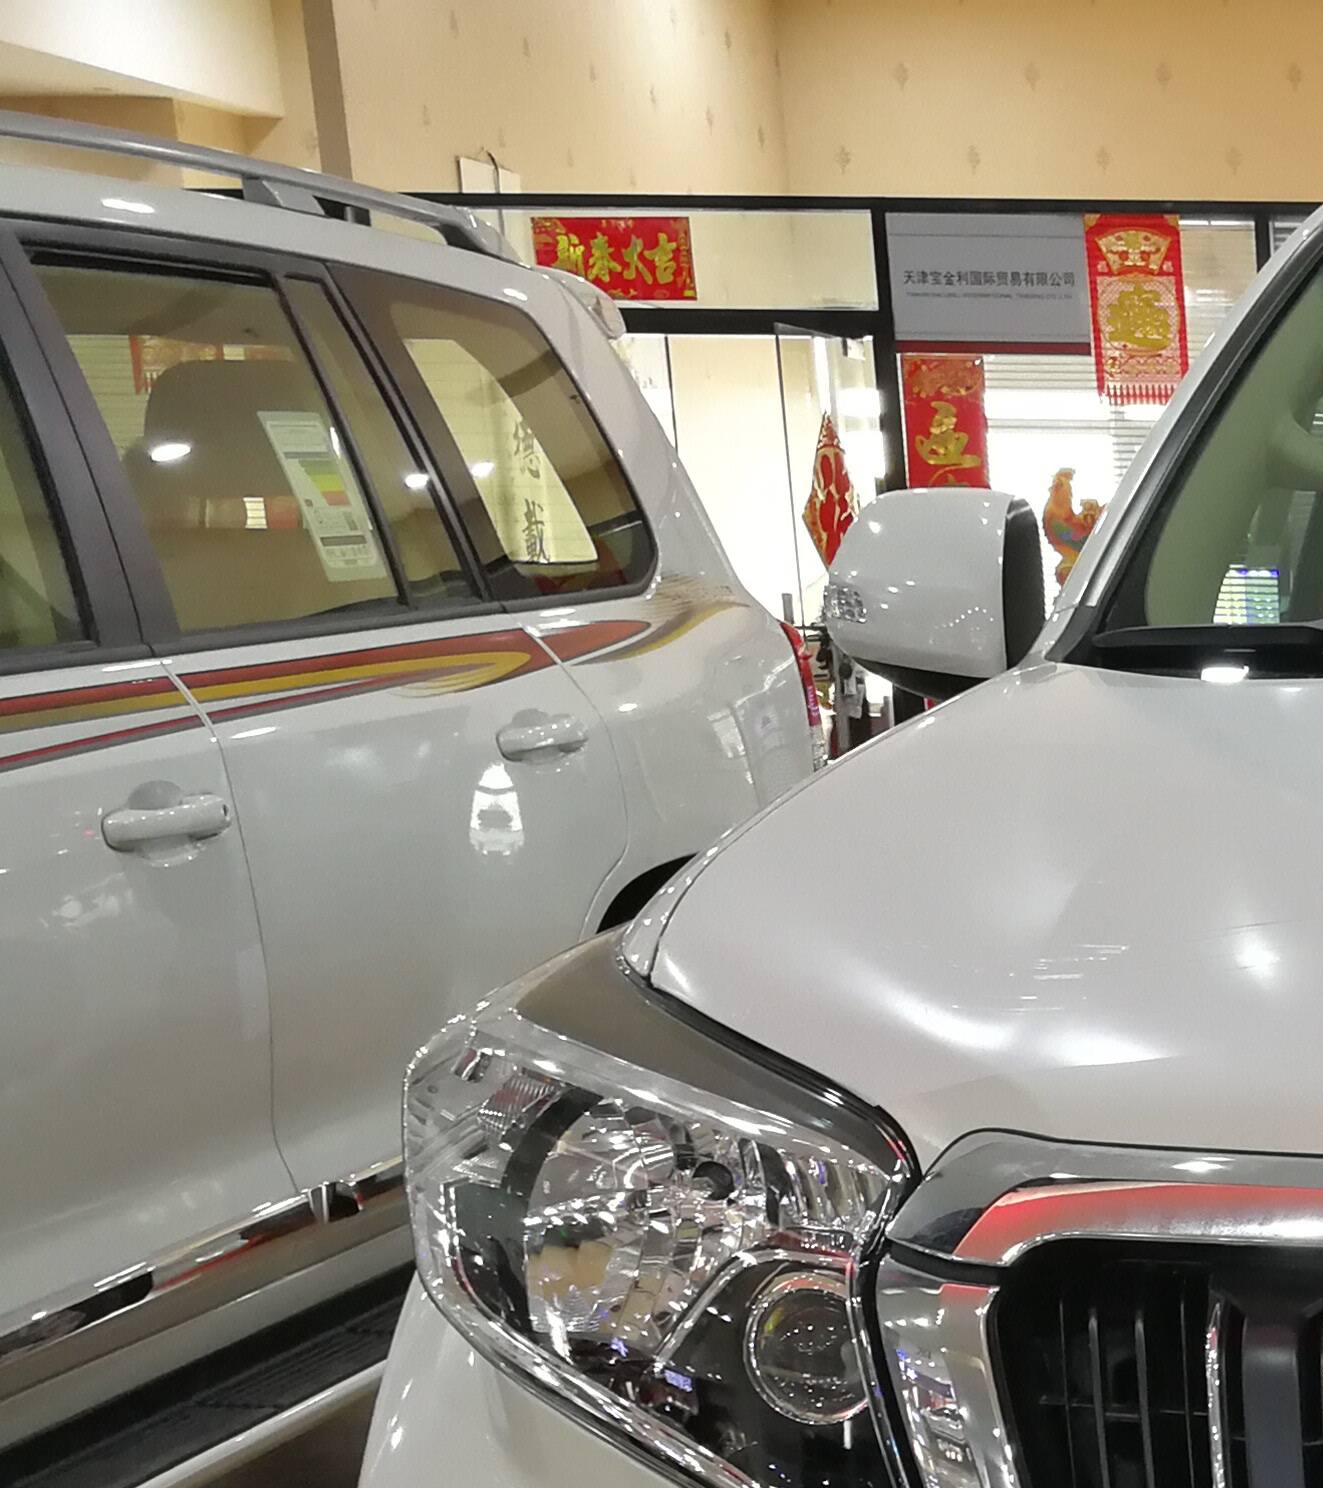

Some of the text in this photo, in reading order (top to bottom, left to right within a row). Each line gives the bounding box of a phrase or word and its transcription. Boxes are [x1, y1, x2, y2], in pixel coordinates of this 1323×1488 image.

[903, 270, 1075, 288] 天津宝金利国际贸易有限公司
